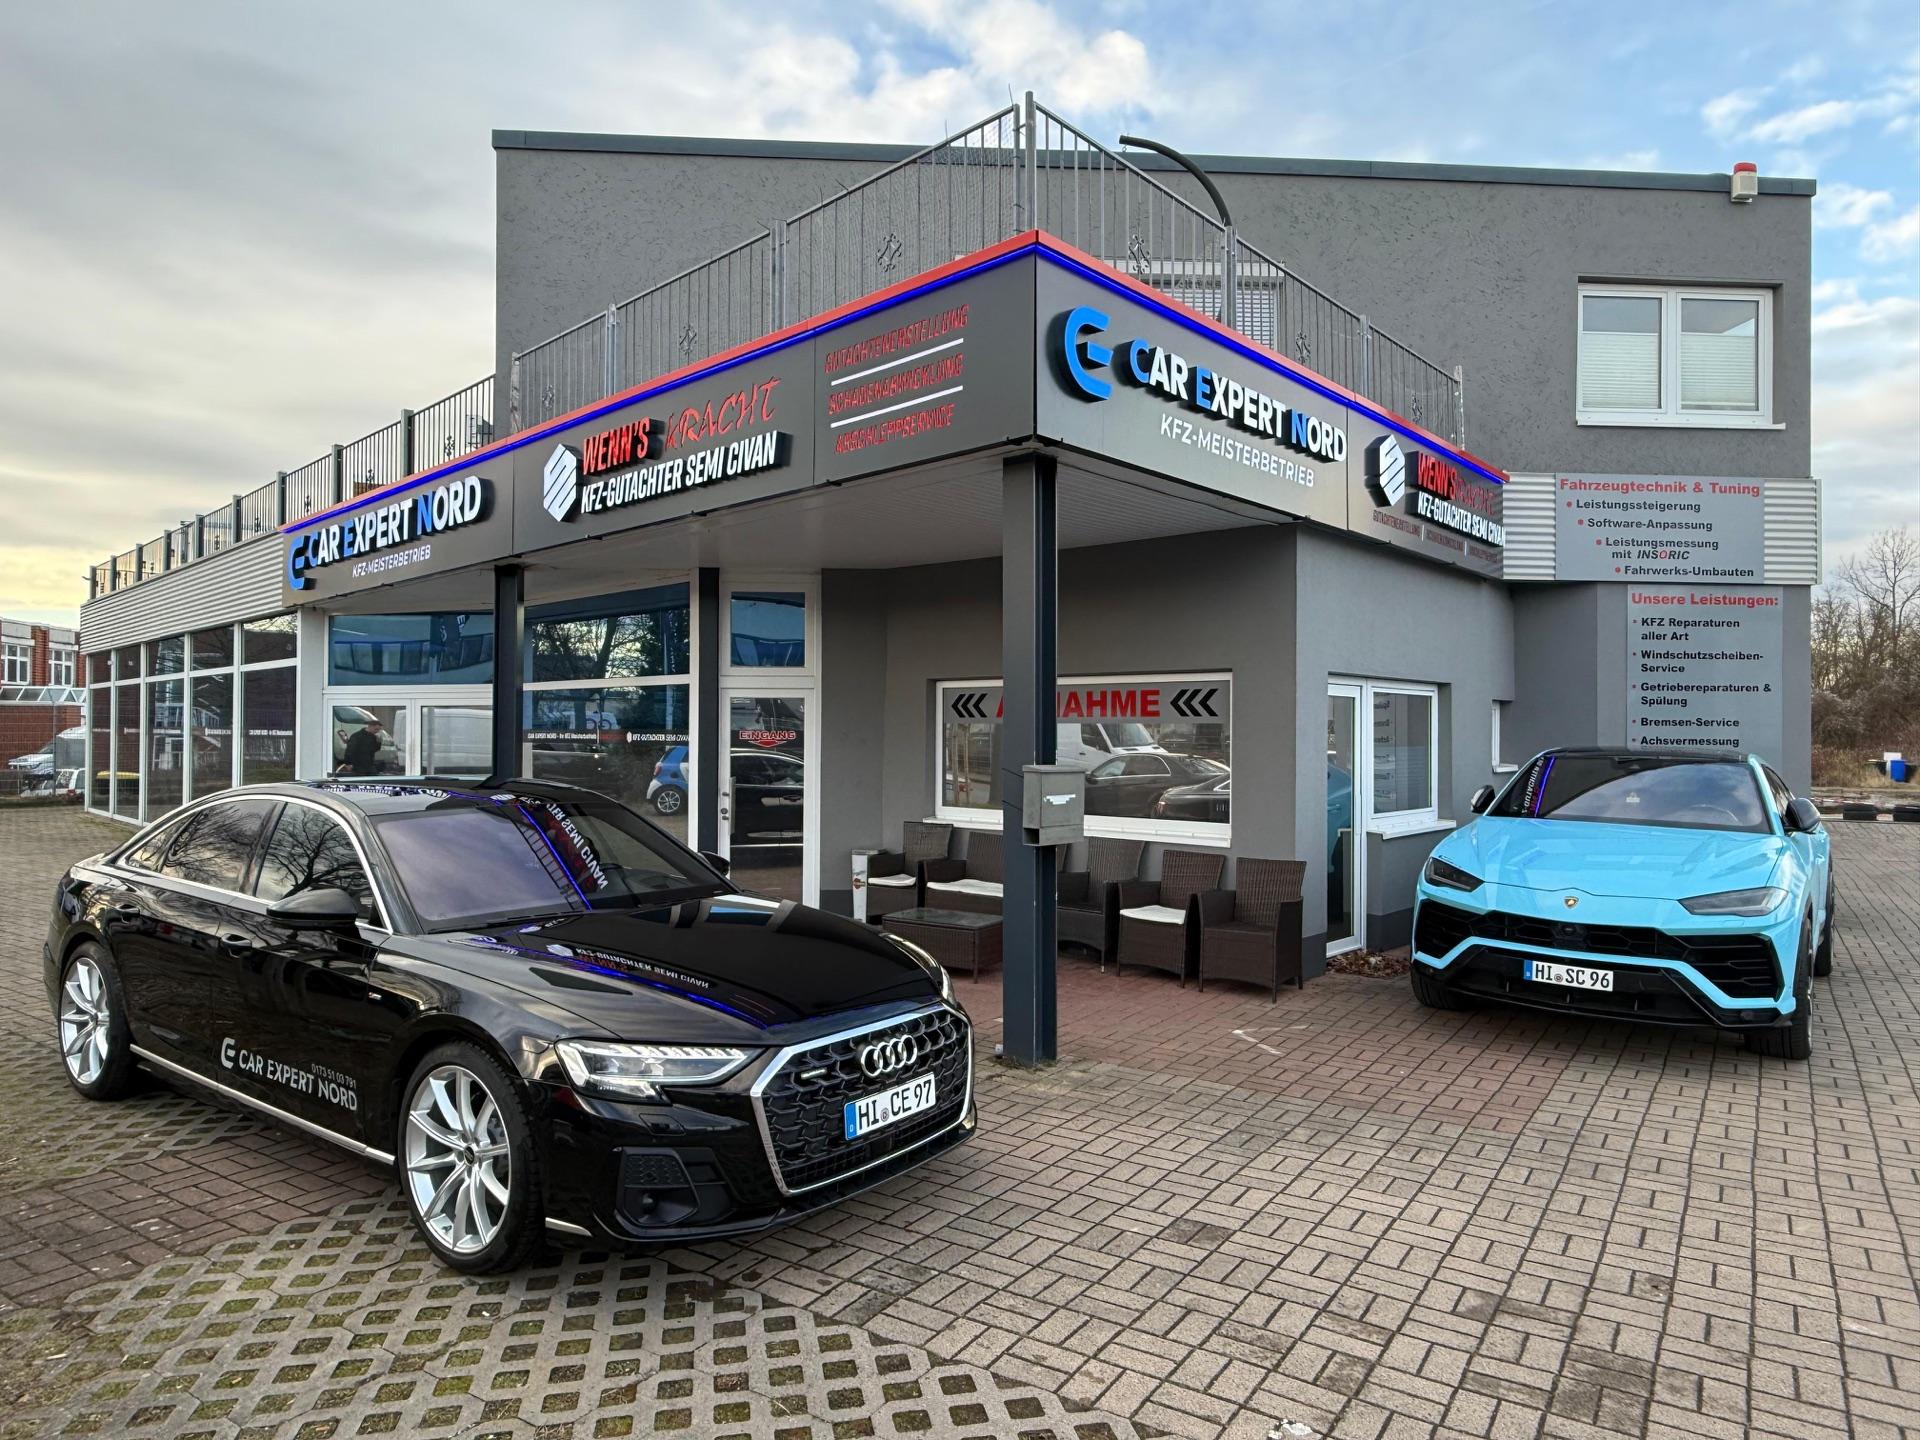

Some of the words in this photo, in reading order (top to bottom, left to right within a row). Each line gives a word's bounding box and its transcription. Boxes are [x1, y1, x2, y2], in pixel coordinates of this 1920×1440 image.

[1130, 337, 1188, 400] CAR
[1196, 365, 1286, 438] EXPERT
[1291, 408, 1346, 462] NORD
[583, 417, 650, 475] WENN'S
[1160, 413, 1314, 488] KFZ-MEISTERBETRIEB
[581, 458, 682, 514] KFZ-GUTACHTER
[686, 446, 724, 486] SEMI
[727, 430, 778, 476] CIVAN
[1418, 452, 1456, 499] WENN'S
[1560, 479, 1686, 494] Fahrzeugtechnik
[1692, 482, 1704, 493] &
[1710, 482, 1760, 496] Tuning
[1576, 499, 1701, 512] Leistungssteigerung
[308, 525, 340, 568] CAR
[344, 498, 414, 558] EXPERT
[416, 476, 482, 536] NORD
[1418, 490, 1471, 532] KFZ-GUTACHTER
[1472, 514, 1488, 540] SEMI
[1588, 518, 1712, 532] Software-Anpassung
[1606, 537, 1718, 550] Leistungsmessung
[352, 543, 431, 578] KFZ-MEISTERBETRIEB
[1612, 550, 1632, 558] mit
[1638, 550, 1690, 560] INSORIC
[1624, 566, 1754, 577] Fahrwerks-Umbauten
[1632, 593, 1686, 604] Unsere
[1691, 594, 1778, 608] Leistungen:
[1642, 618, 1664, 626] KFZ
[1669, 618, 1740, 628] Reparaturen
[1641, 632, 1667, 640] aller
[1670, 632, 1689, 640] Art
[1641, 650, 1764, 660] Windschutzscheiben-
[1641, 664, 1685, 672] Service
[1641, 683, 1759, 694] Getriebereparaturen
[1764, 684, 1772, 692] &
[1641, 696, 1688, 707] Spülung
[1641, 718, 1740, 727] Bremsen-Service
[738, 730, 796, 740] EINGANG
[1641, 736, 1740, 748] Achsvermessung
[1536, 963, 1553, 981] HI
[1566, 968, 1585, 985] SC
[1590, 971, 1610, 989] 96
[239, 1050, 262, 1075] CAR
[267, 1060, 314, 1094] EXPERT
[318, 1078, 357, 1110] NORD
[312, 1064, 327, 1077] 0173
[328, 1070, 336, 1080] 51
[336, 1073, 344, 1084] 03
[346, 1076, 356, 1089] 791
[858, 1100, 880, 1130] HI
[890, 1087, 912, 1116] CE
[914, 1078, 932, 1108] 97
